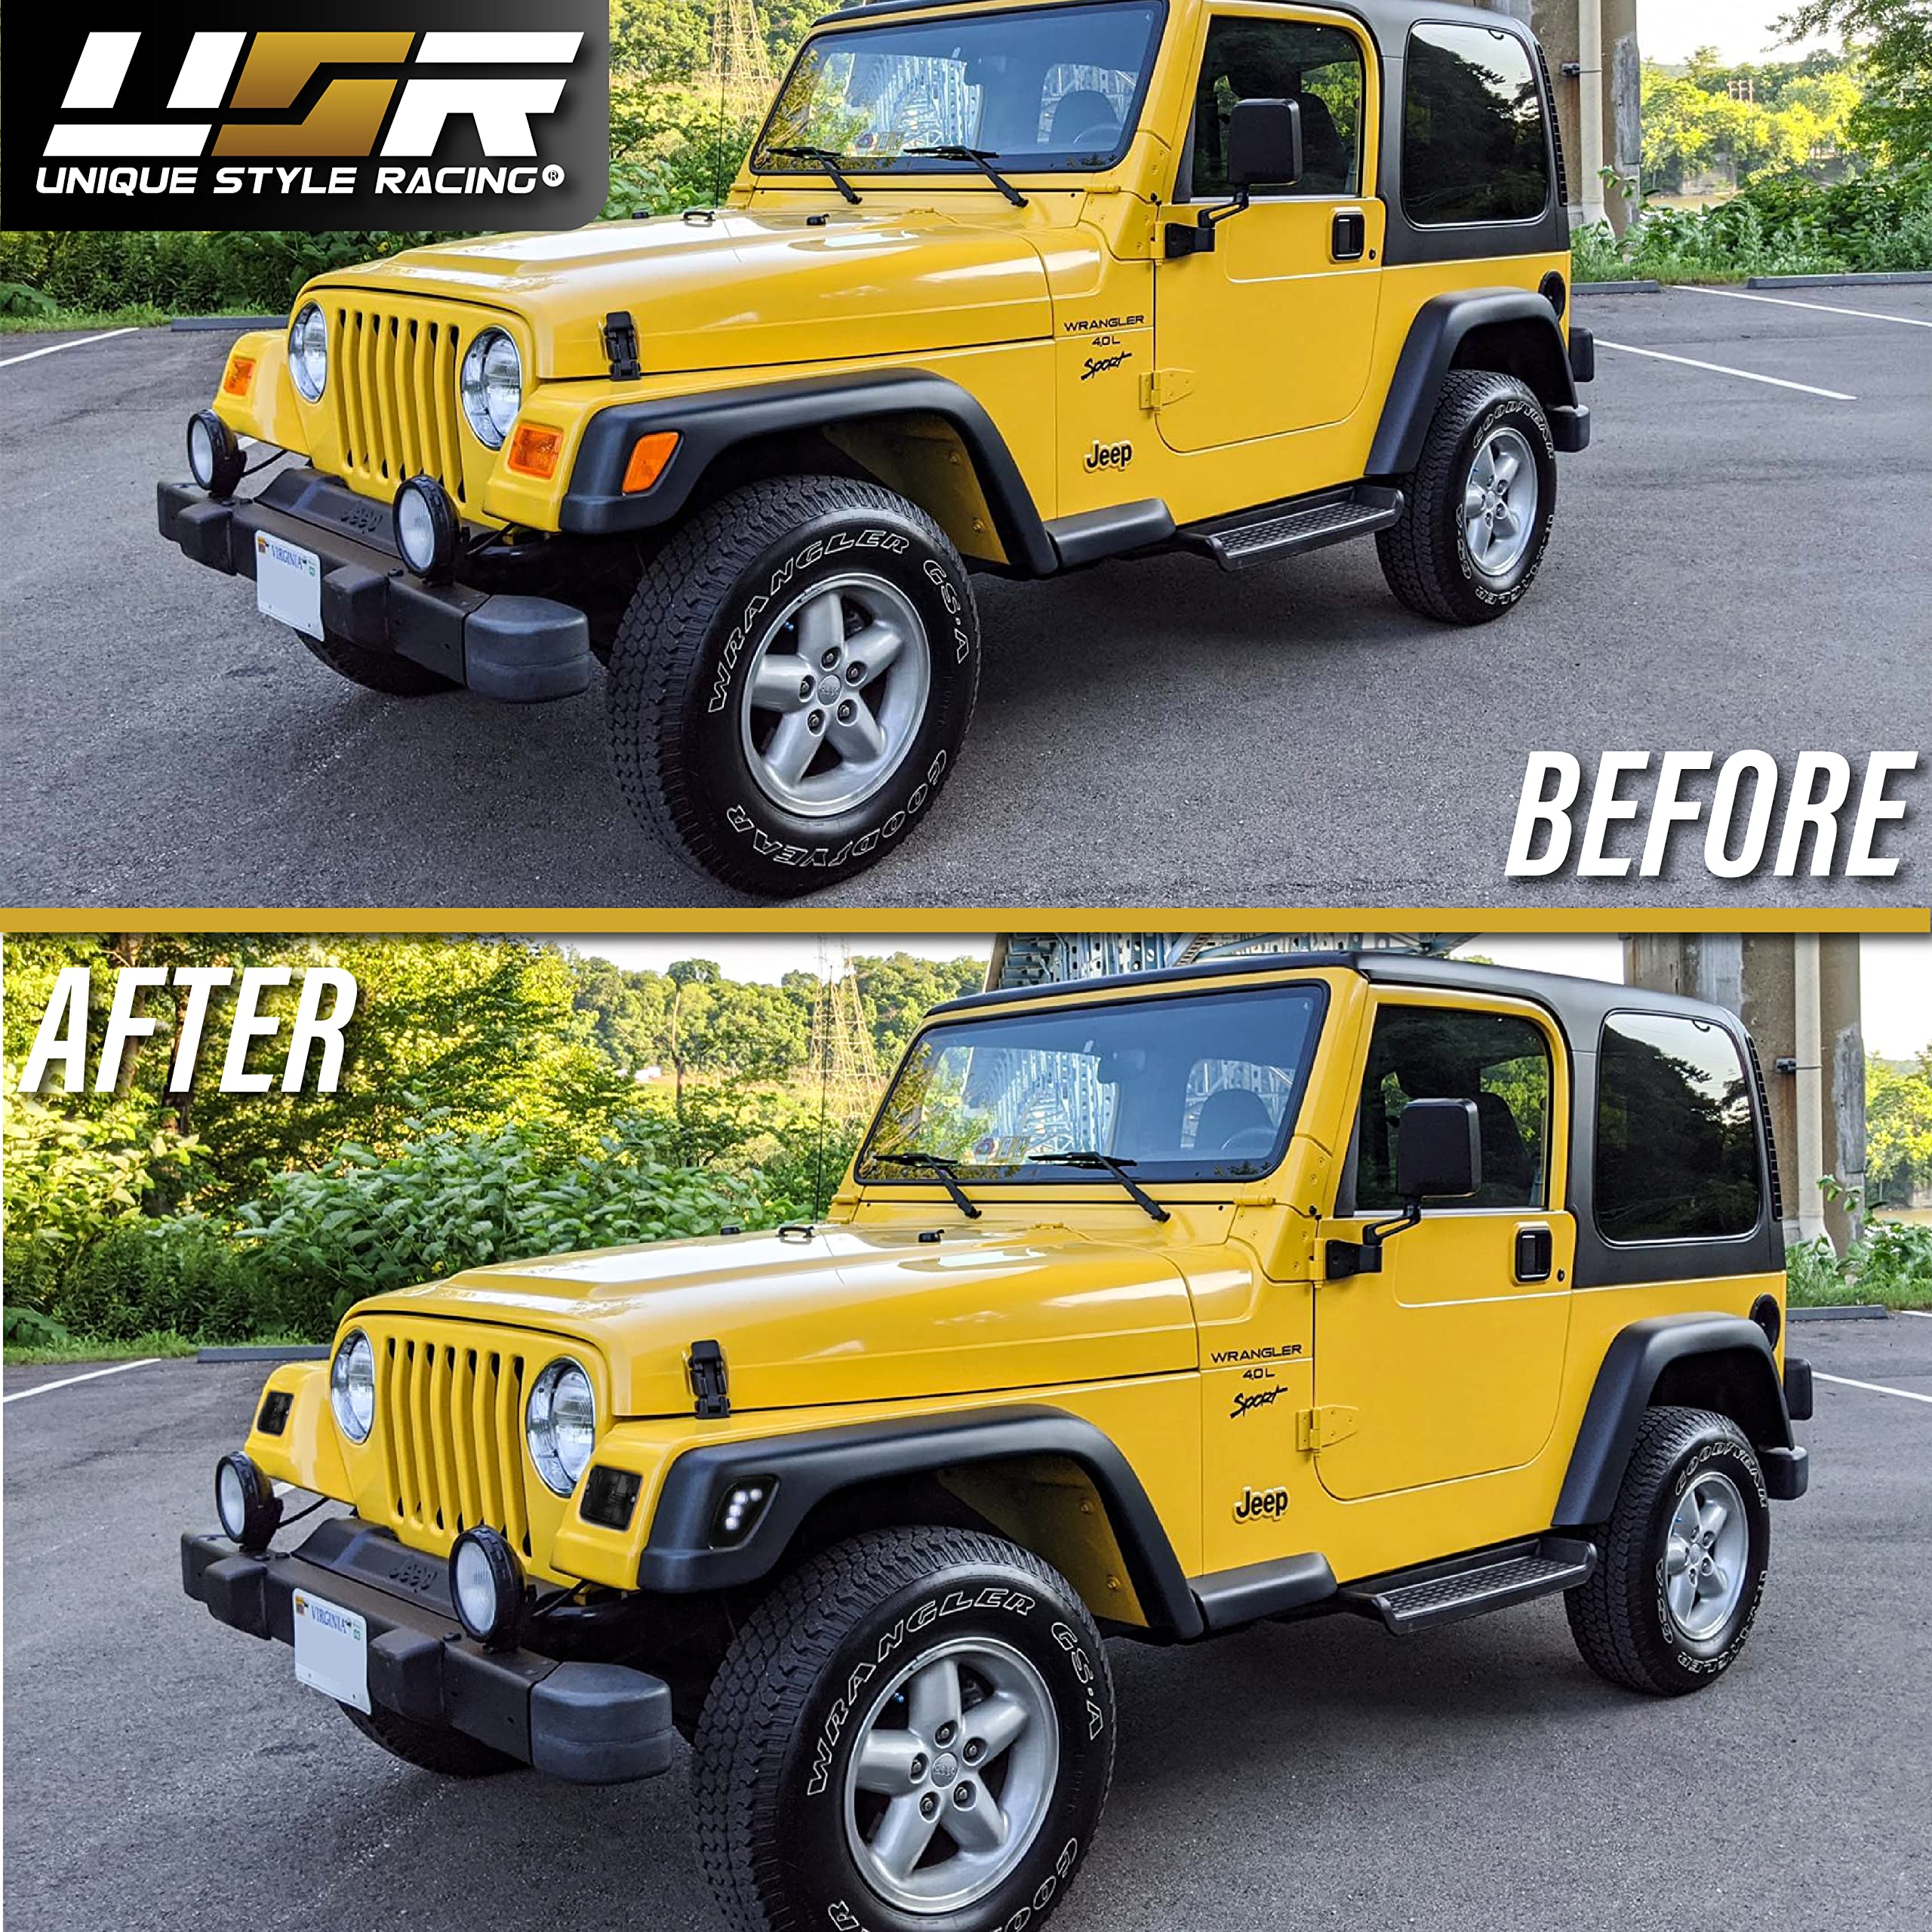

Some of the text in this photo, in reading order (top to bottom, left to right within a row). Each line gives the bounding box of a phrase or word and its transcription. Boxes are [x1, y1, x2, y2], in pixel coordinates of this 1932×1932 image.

[1064, 315, 1145, 332] WRANGLER
[1080, 351, 1132, 380] Sport
[1084, 440, 1134, 472] Jeep
[707, 529, 910, 713] WRANGLER
[726, 749, 948, 867] GOODYEAR
[1211, 1343, 1303, 1364] WRANGLER
[1229, 1384, 1289, 1420] Sport
[1234, 1487, 1289, 1523] Jeep
[310, 1604, 347, 1635] VIRGINIA
[807, 1587, 1037, 1796] WRANGLER
